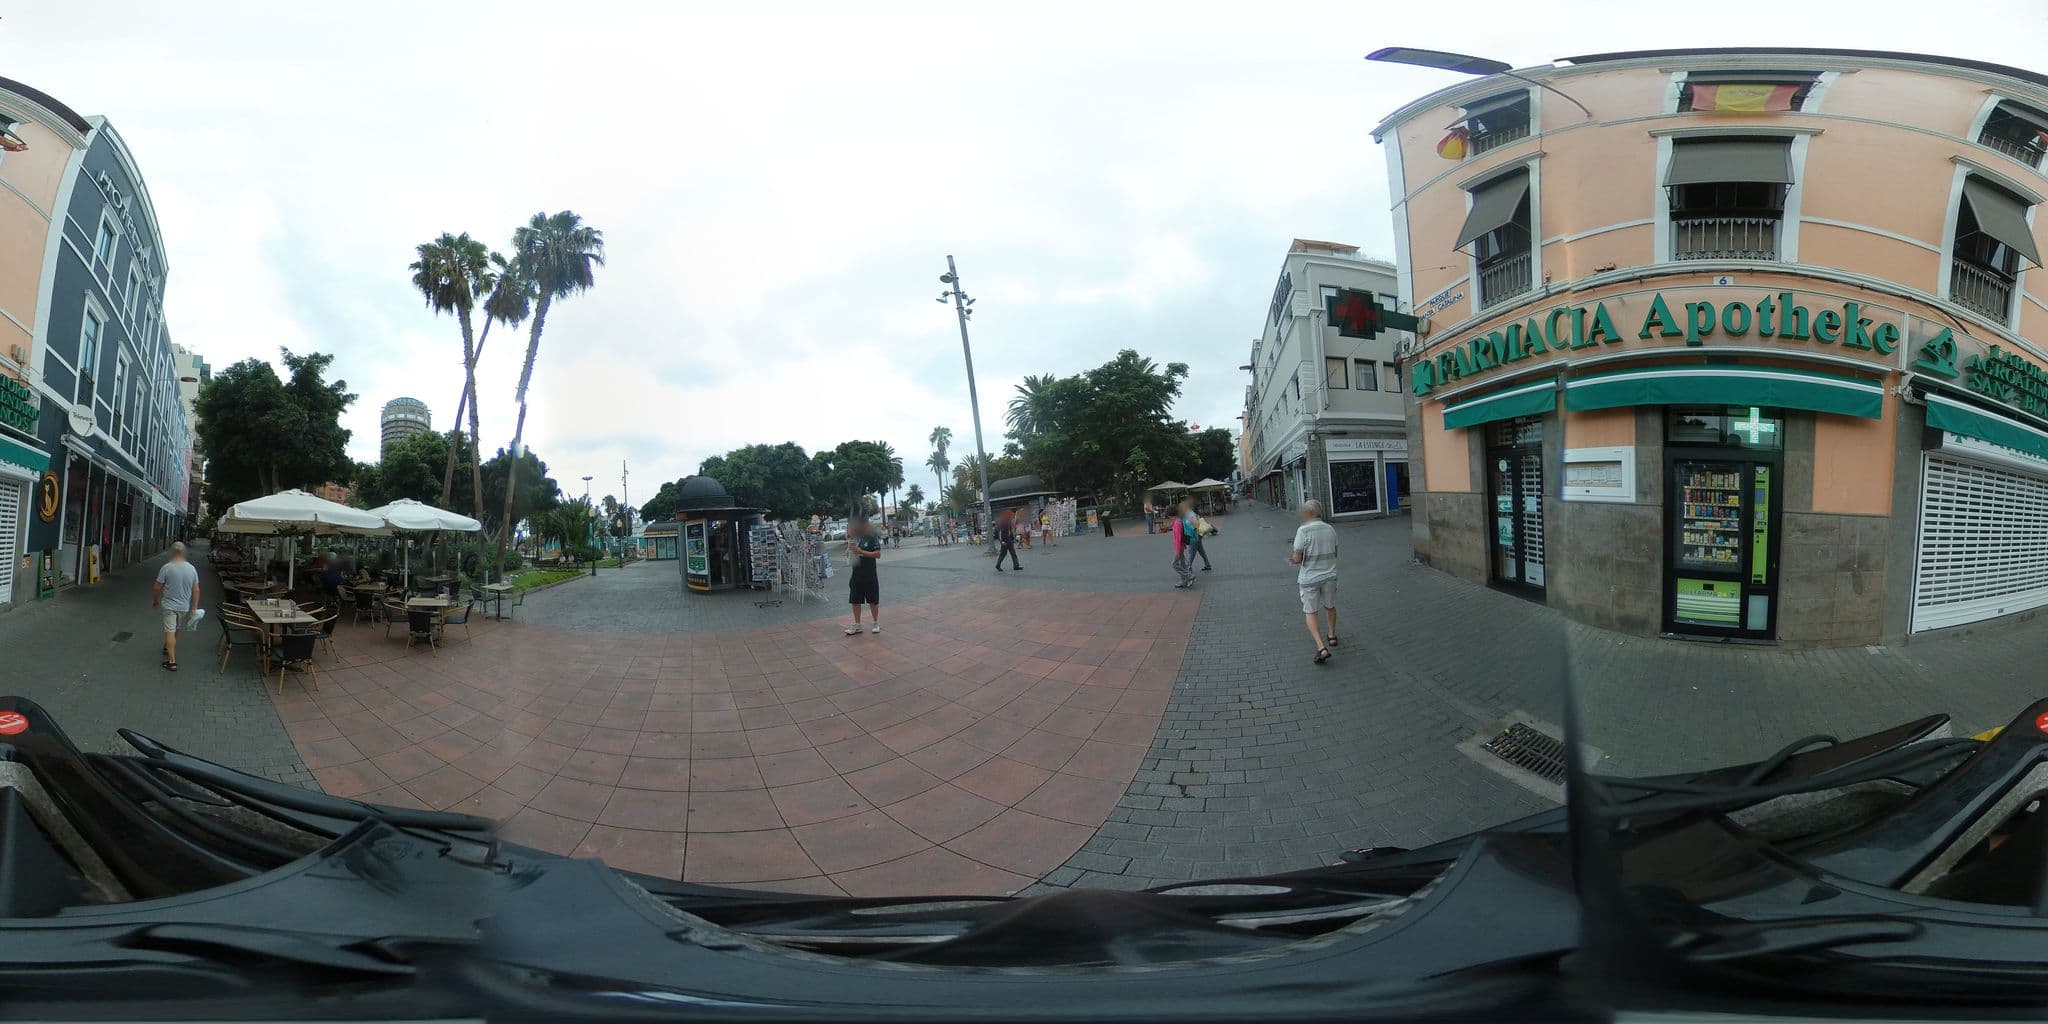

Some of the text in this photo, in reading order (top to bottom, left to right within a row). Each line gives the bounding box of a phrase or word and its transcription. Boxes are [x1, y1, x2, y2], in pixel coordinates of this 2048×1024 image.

[98, 170, 142, 245] HOTEL
[1437, 292, 1463, 311] CATALINA
[1719, 276, 1727, 285] 6
[1436, 292, 1900, 386] FARMACIA Apotheke
